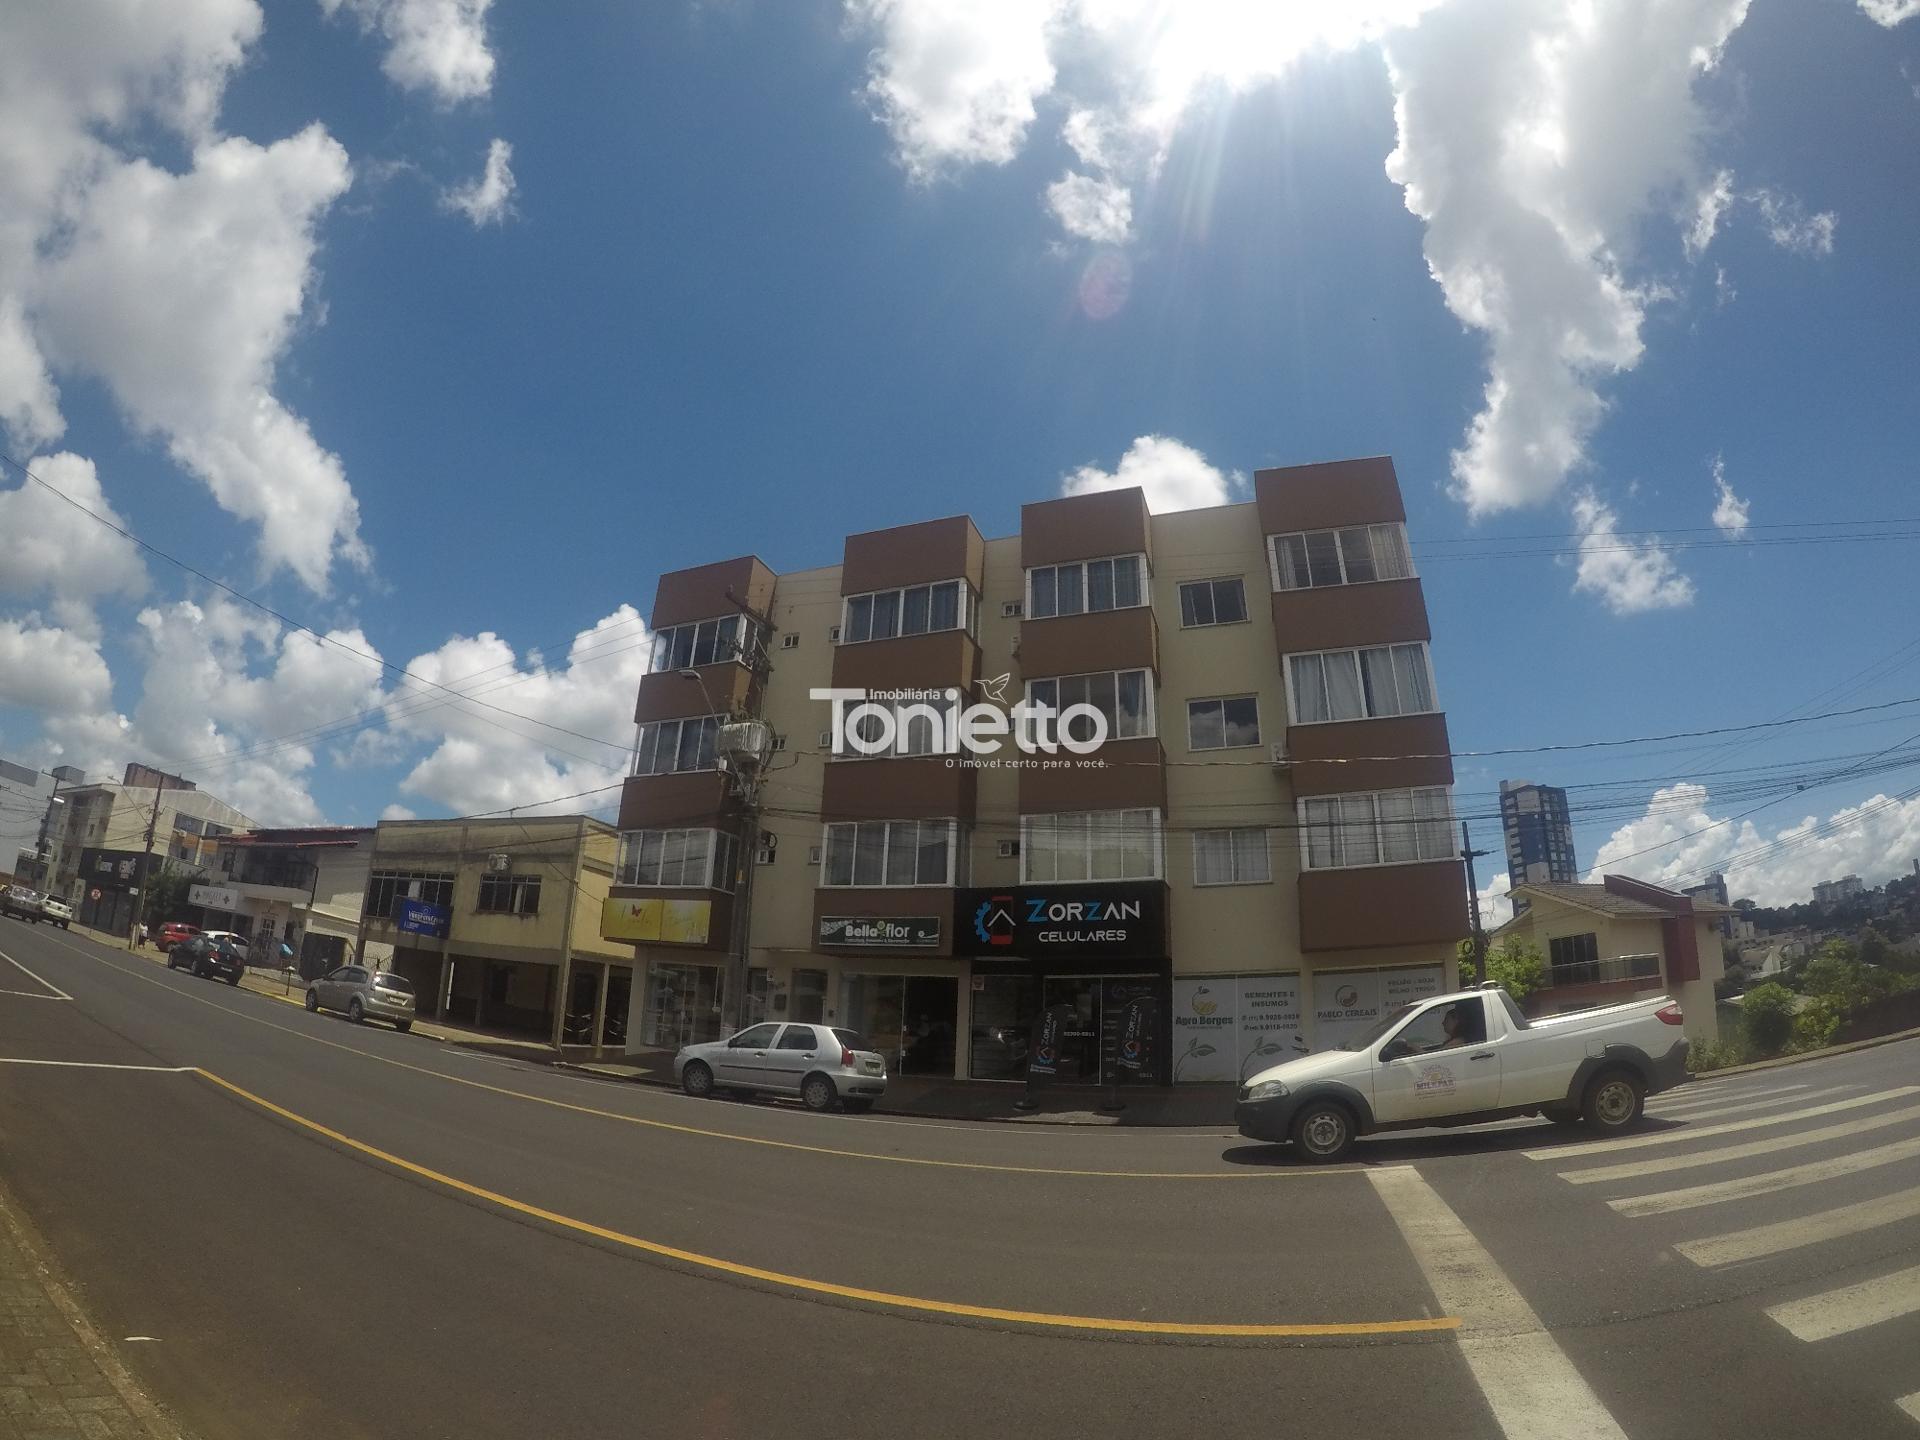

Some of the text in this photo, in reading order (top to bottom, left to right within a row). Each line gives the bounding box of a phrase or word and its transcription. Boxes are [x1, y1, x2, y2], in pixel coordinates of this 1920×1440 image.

[1026, 900, 1141, 922] ZORZAN
[845, 924, 878, 937] Bella
[1038, 930, 1127, 943] CELULARES
[1251, 1000, 1289, 1008] INSUMOS
[1317, 1011, 1343, 1019] PABLO
[1344, 1009, 1377, 1018] CEREAIS
[1175, 1016, 1234, 1026] Agro Borges
